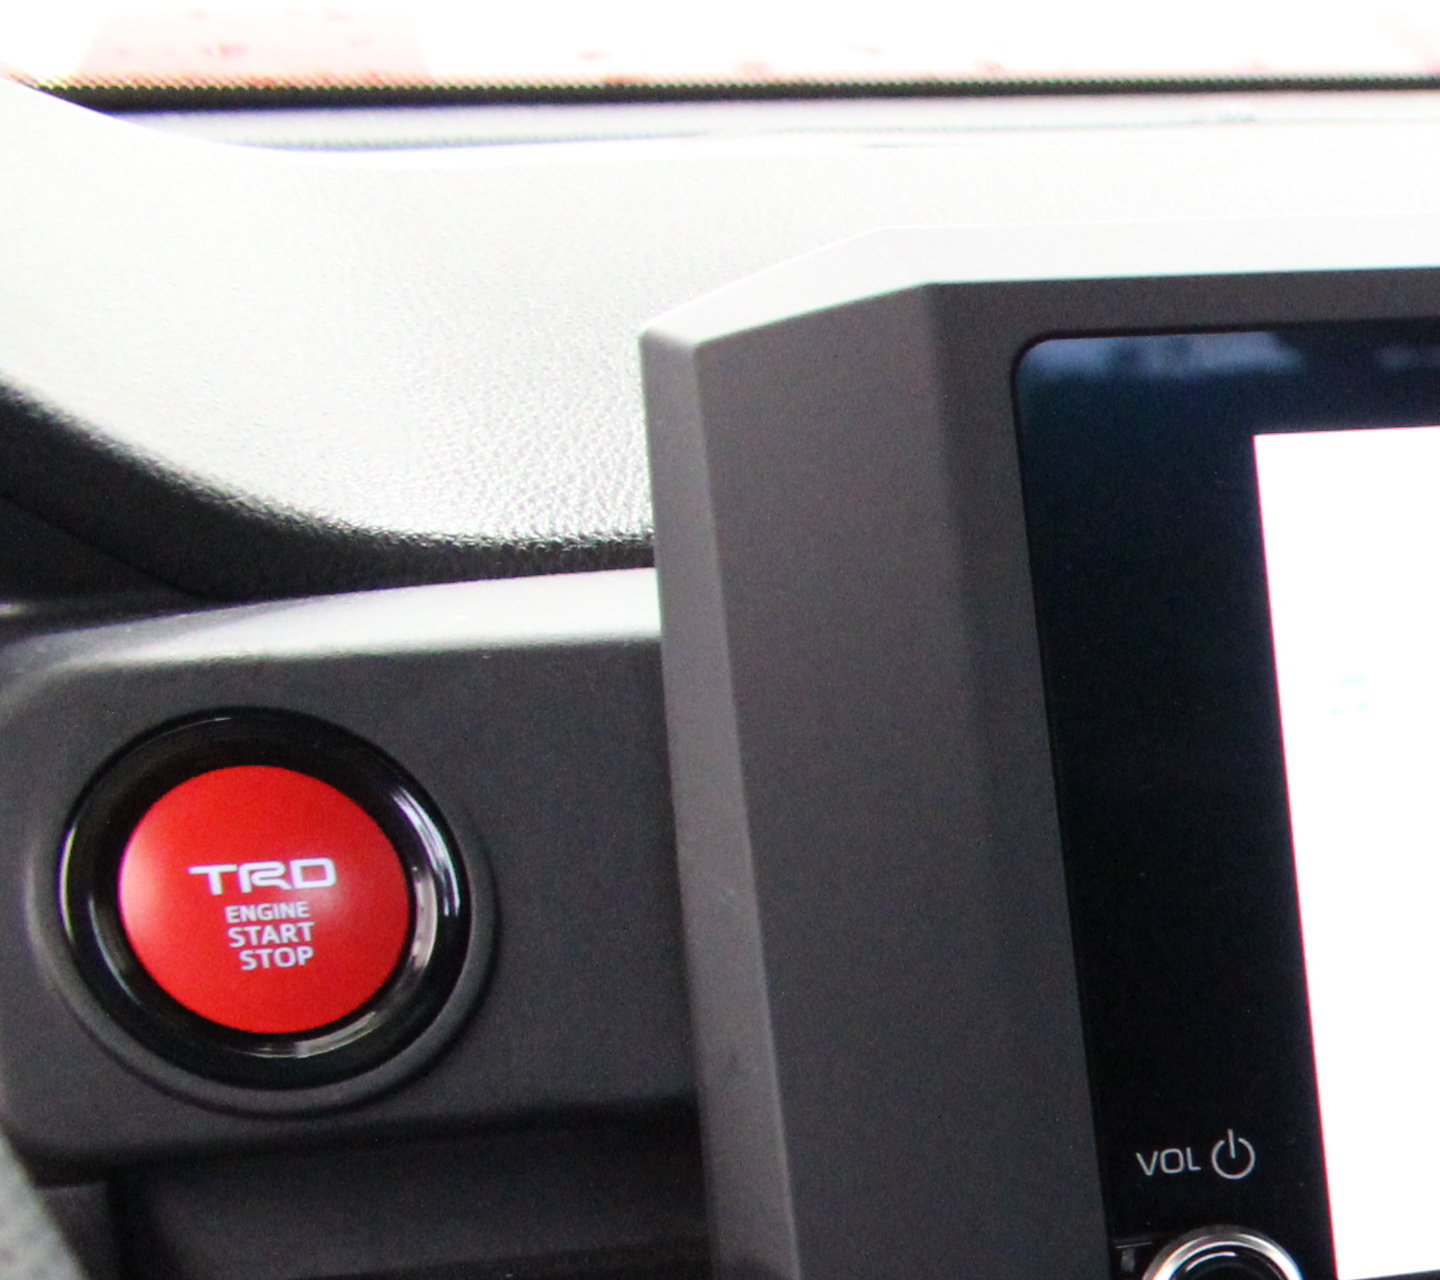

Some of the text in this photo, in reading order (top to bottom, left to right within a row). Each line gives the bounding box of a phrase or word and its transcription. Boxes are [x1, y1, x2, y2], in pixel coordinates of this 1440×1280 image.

[188, 857, 337, 895] TRD
[225, 901, 311, 924] ENGINE
[227, 922, 314, 948] START
[239, 946, 314, 971] STOP
[1136, 1147, 1201, 1176] VOL
